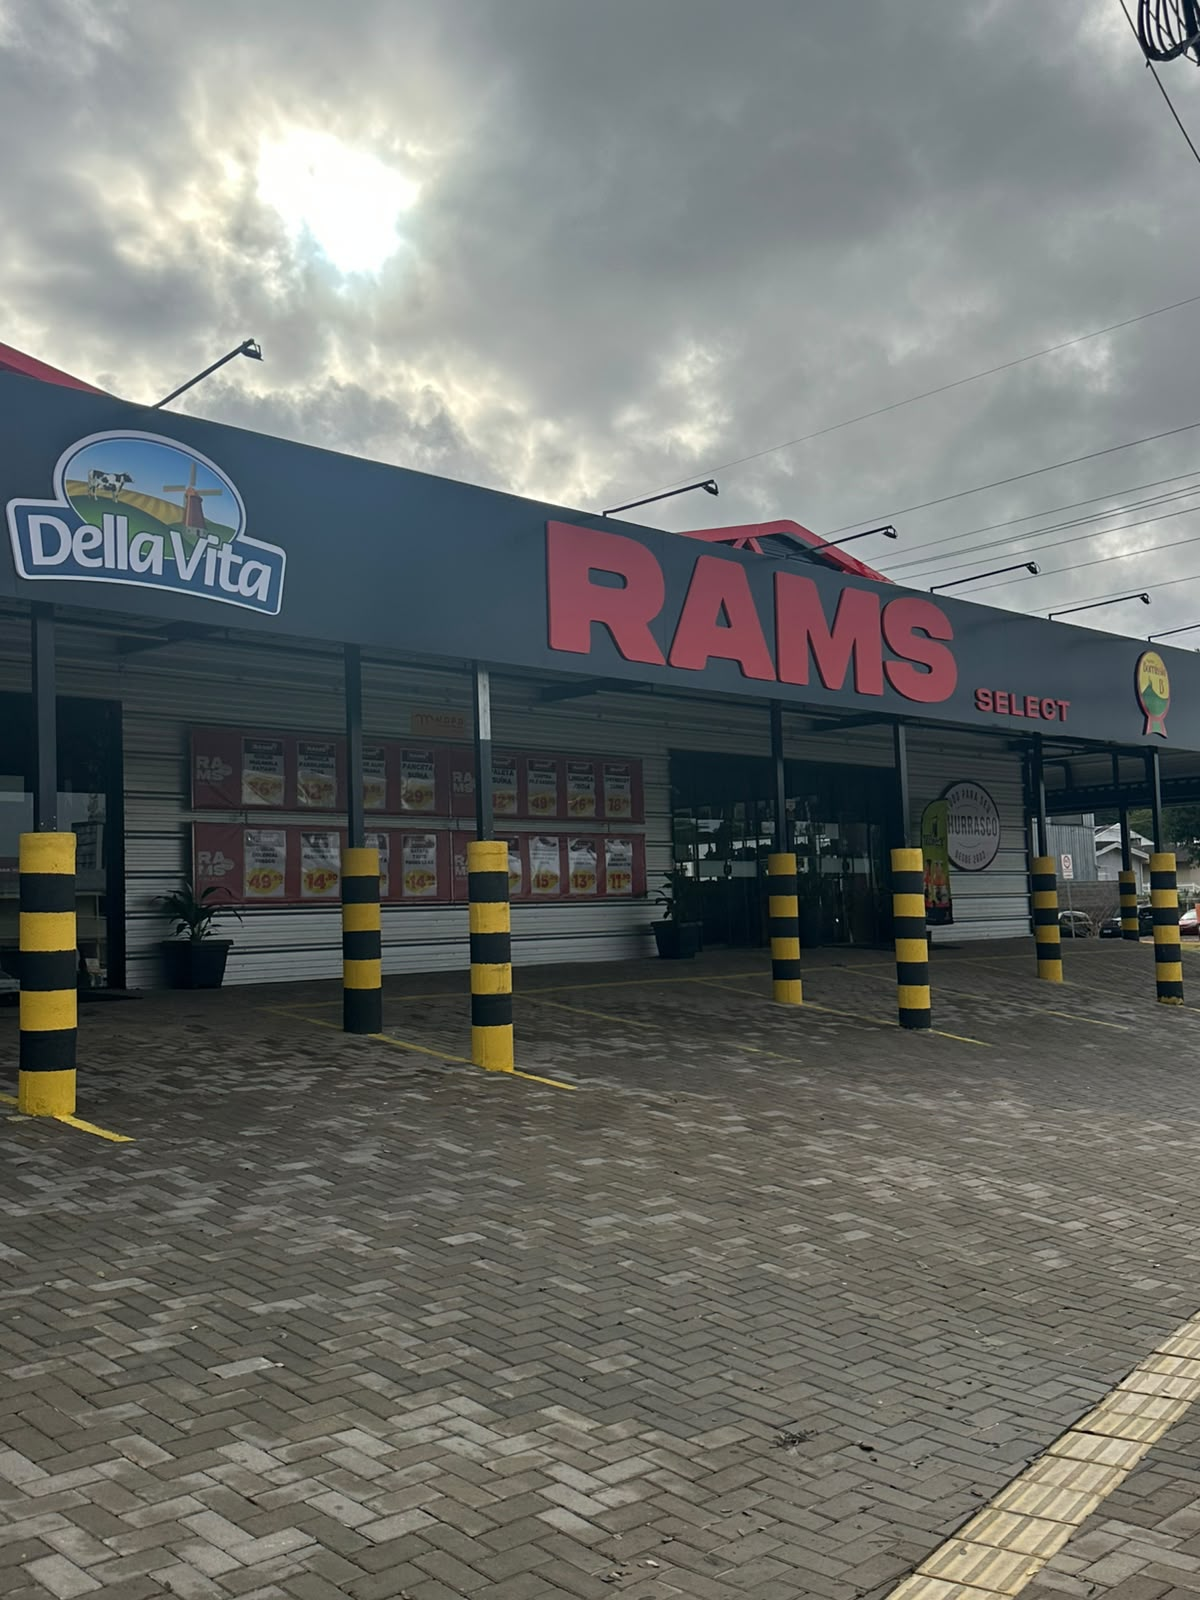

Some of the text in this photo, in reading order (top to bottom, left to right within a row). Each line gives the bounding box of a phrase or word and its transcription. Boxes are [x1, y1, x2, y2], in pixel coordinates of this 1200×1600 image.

[546, 519, 958, 703] RAMS
[974, 687, 1072, 721] SELECT
[491, 769, 515, 777] ALETA
[947, 814, 998, 837] HURRASCO
